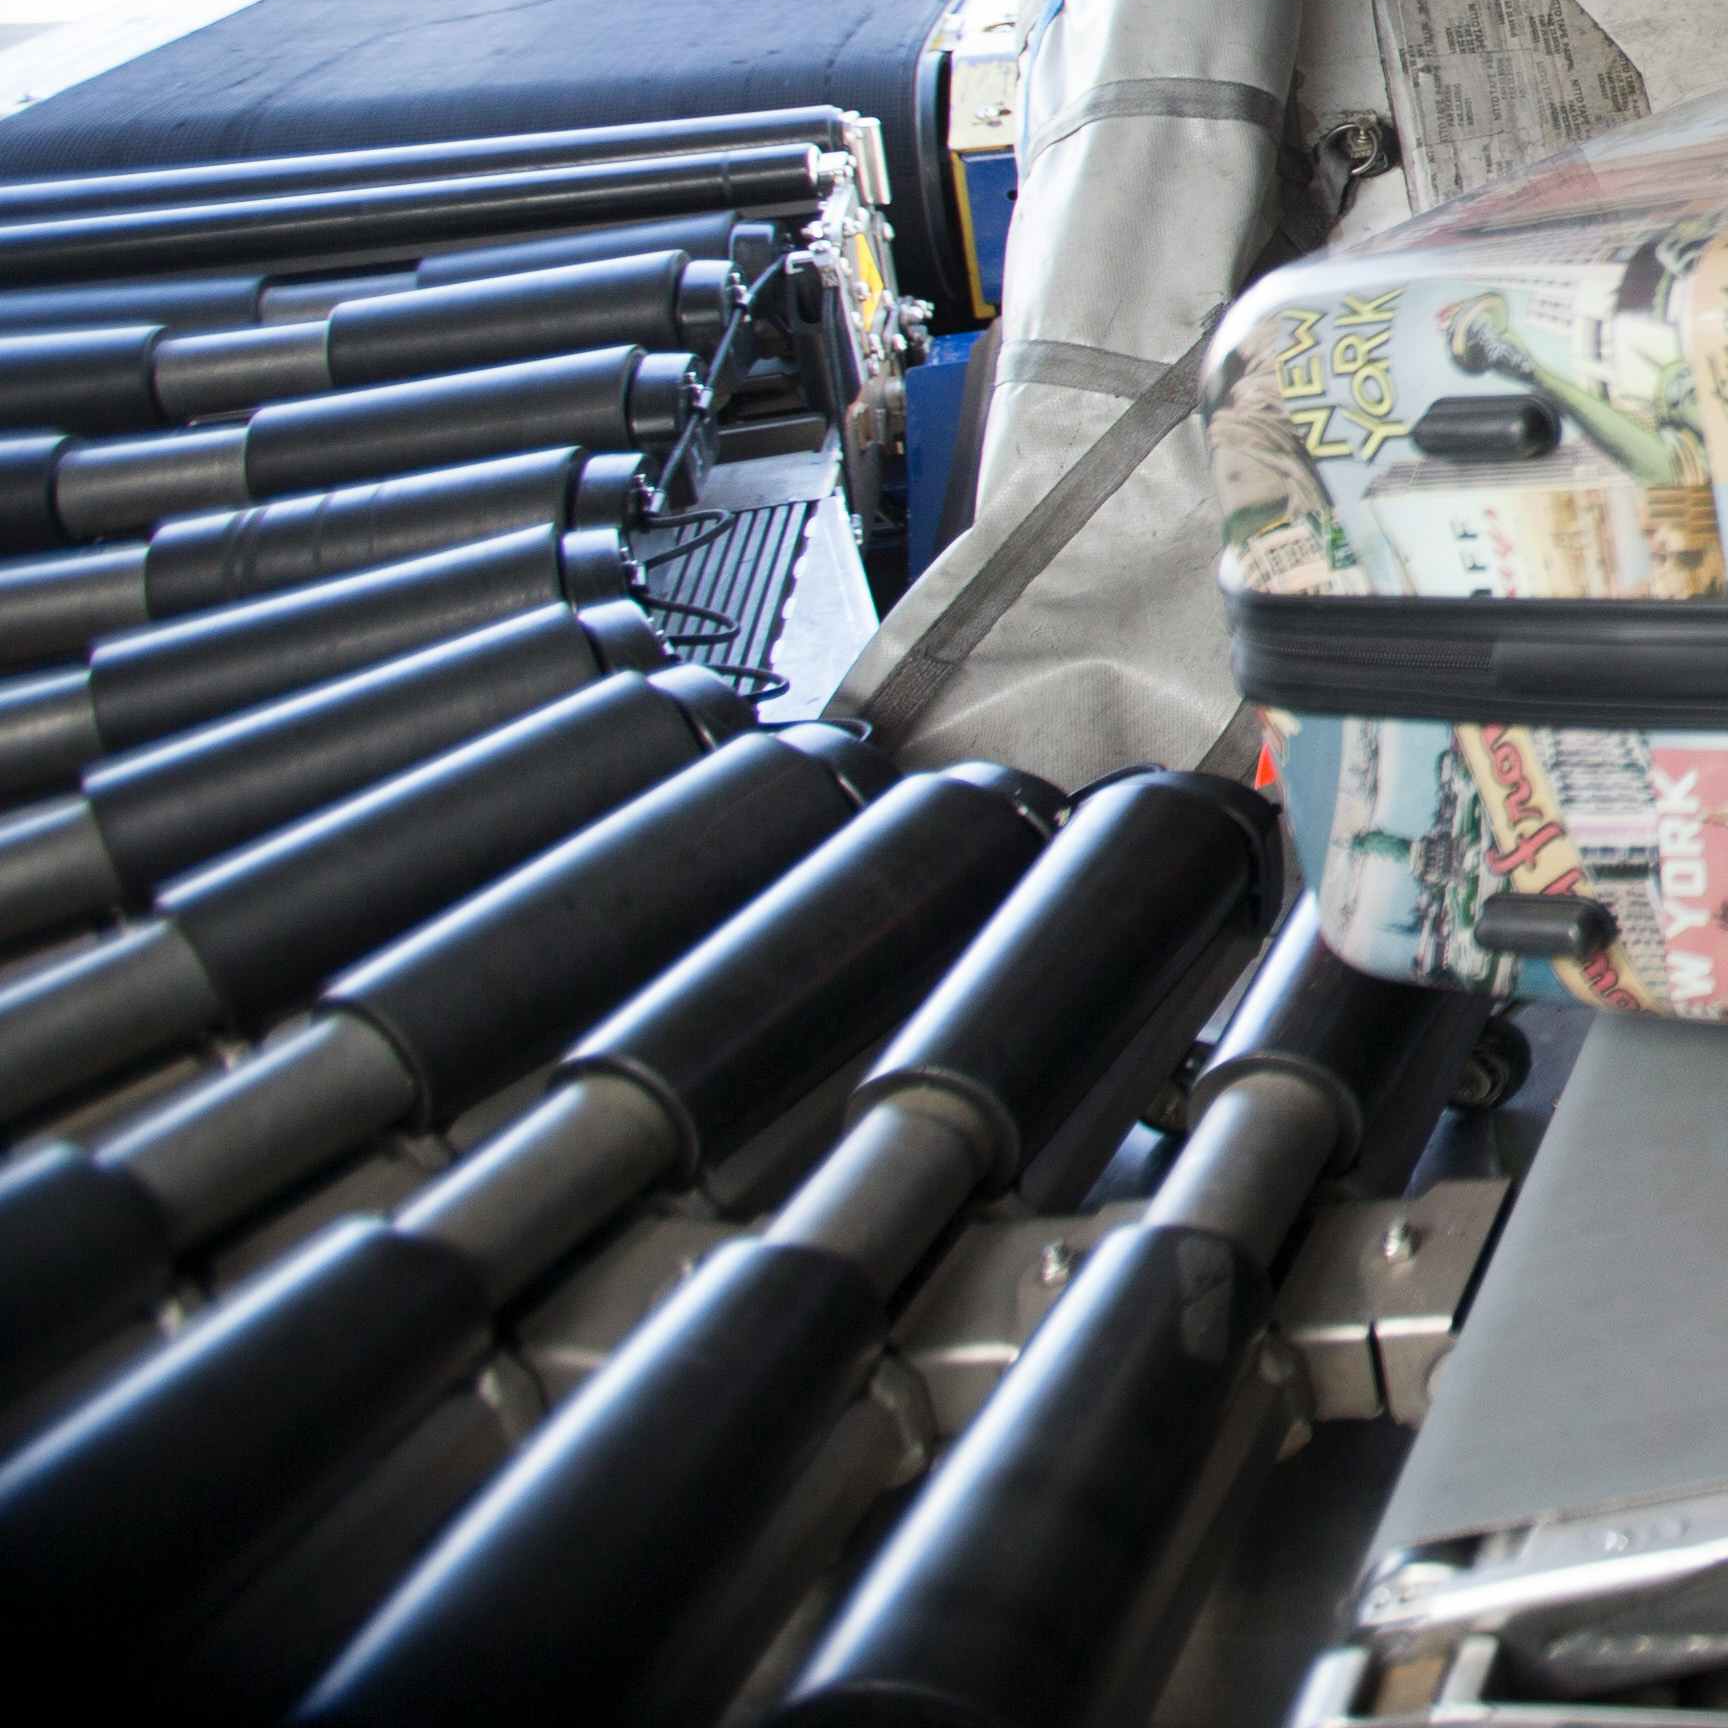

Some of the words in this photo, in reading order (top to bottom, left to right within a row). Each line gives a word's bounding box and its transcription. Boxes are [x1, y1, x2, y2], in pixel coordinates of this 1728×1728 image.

[1276, 308, 1355, 459] NEW
[1331, 287, 1412, 463] YORK
[1656, 770, 1710, 943] YORK
